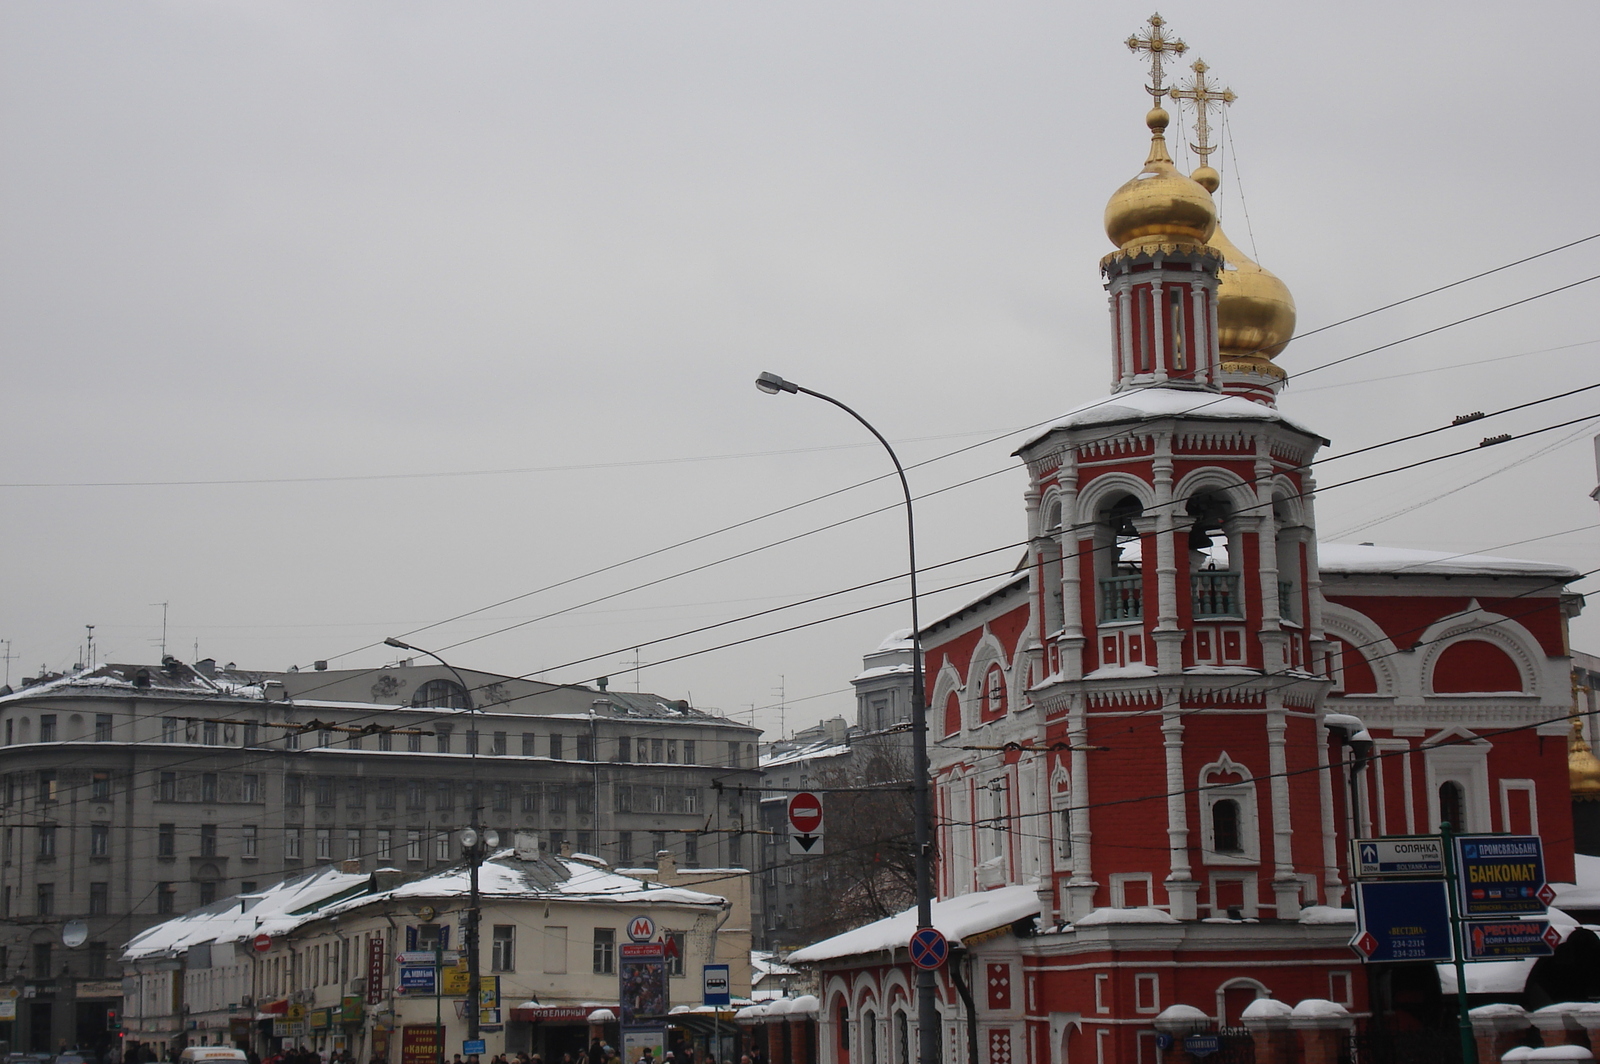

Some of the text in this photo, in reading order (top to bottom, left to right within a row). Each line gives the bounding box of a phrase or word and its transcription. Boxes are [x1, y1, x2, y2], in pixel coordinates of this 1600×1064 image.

[1394, 844, 1438, 853] СОЛЯНКА
[1479, 843, 1537, 855] ПРОМСВЯЗЬБАНК
[1396, 863, 1428, 871] SOLYANKA
[1469, 864, 1536, 883] БАНКОМАТ
[633, 920, 651, 935] М
[1484, 924, 1540, 936] РЕСТОРАН
[1392, 940, 1425, 948] 234-2314
[1392, 949, 1426, 958] 234-2315
[371, 939, 382, 1004] ЮВЕЛИРНЫЙ
[533, 1009, 586, 1018] ЮВЕЛИРНЫЙ
